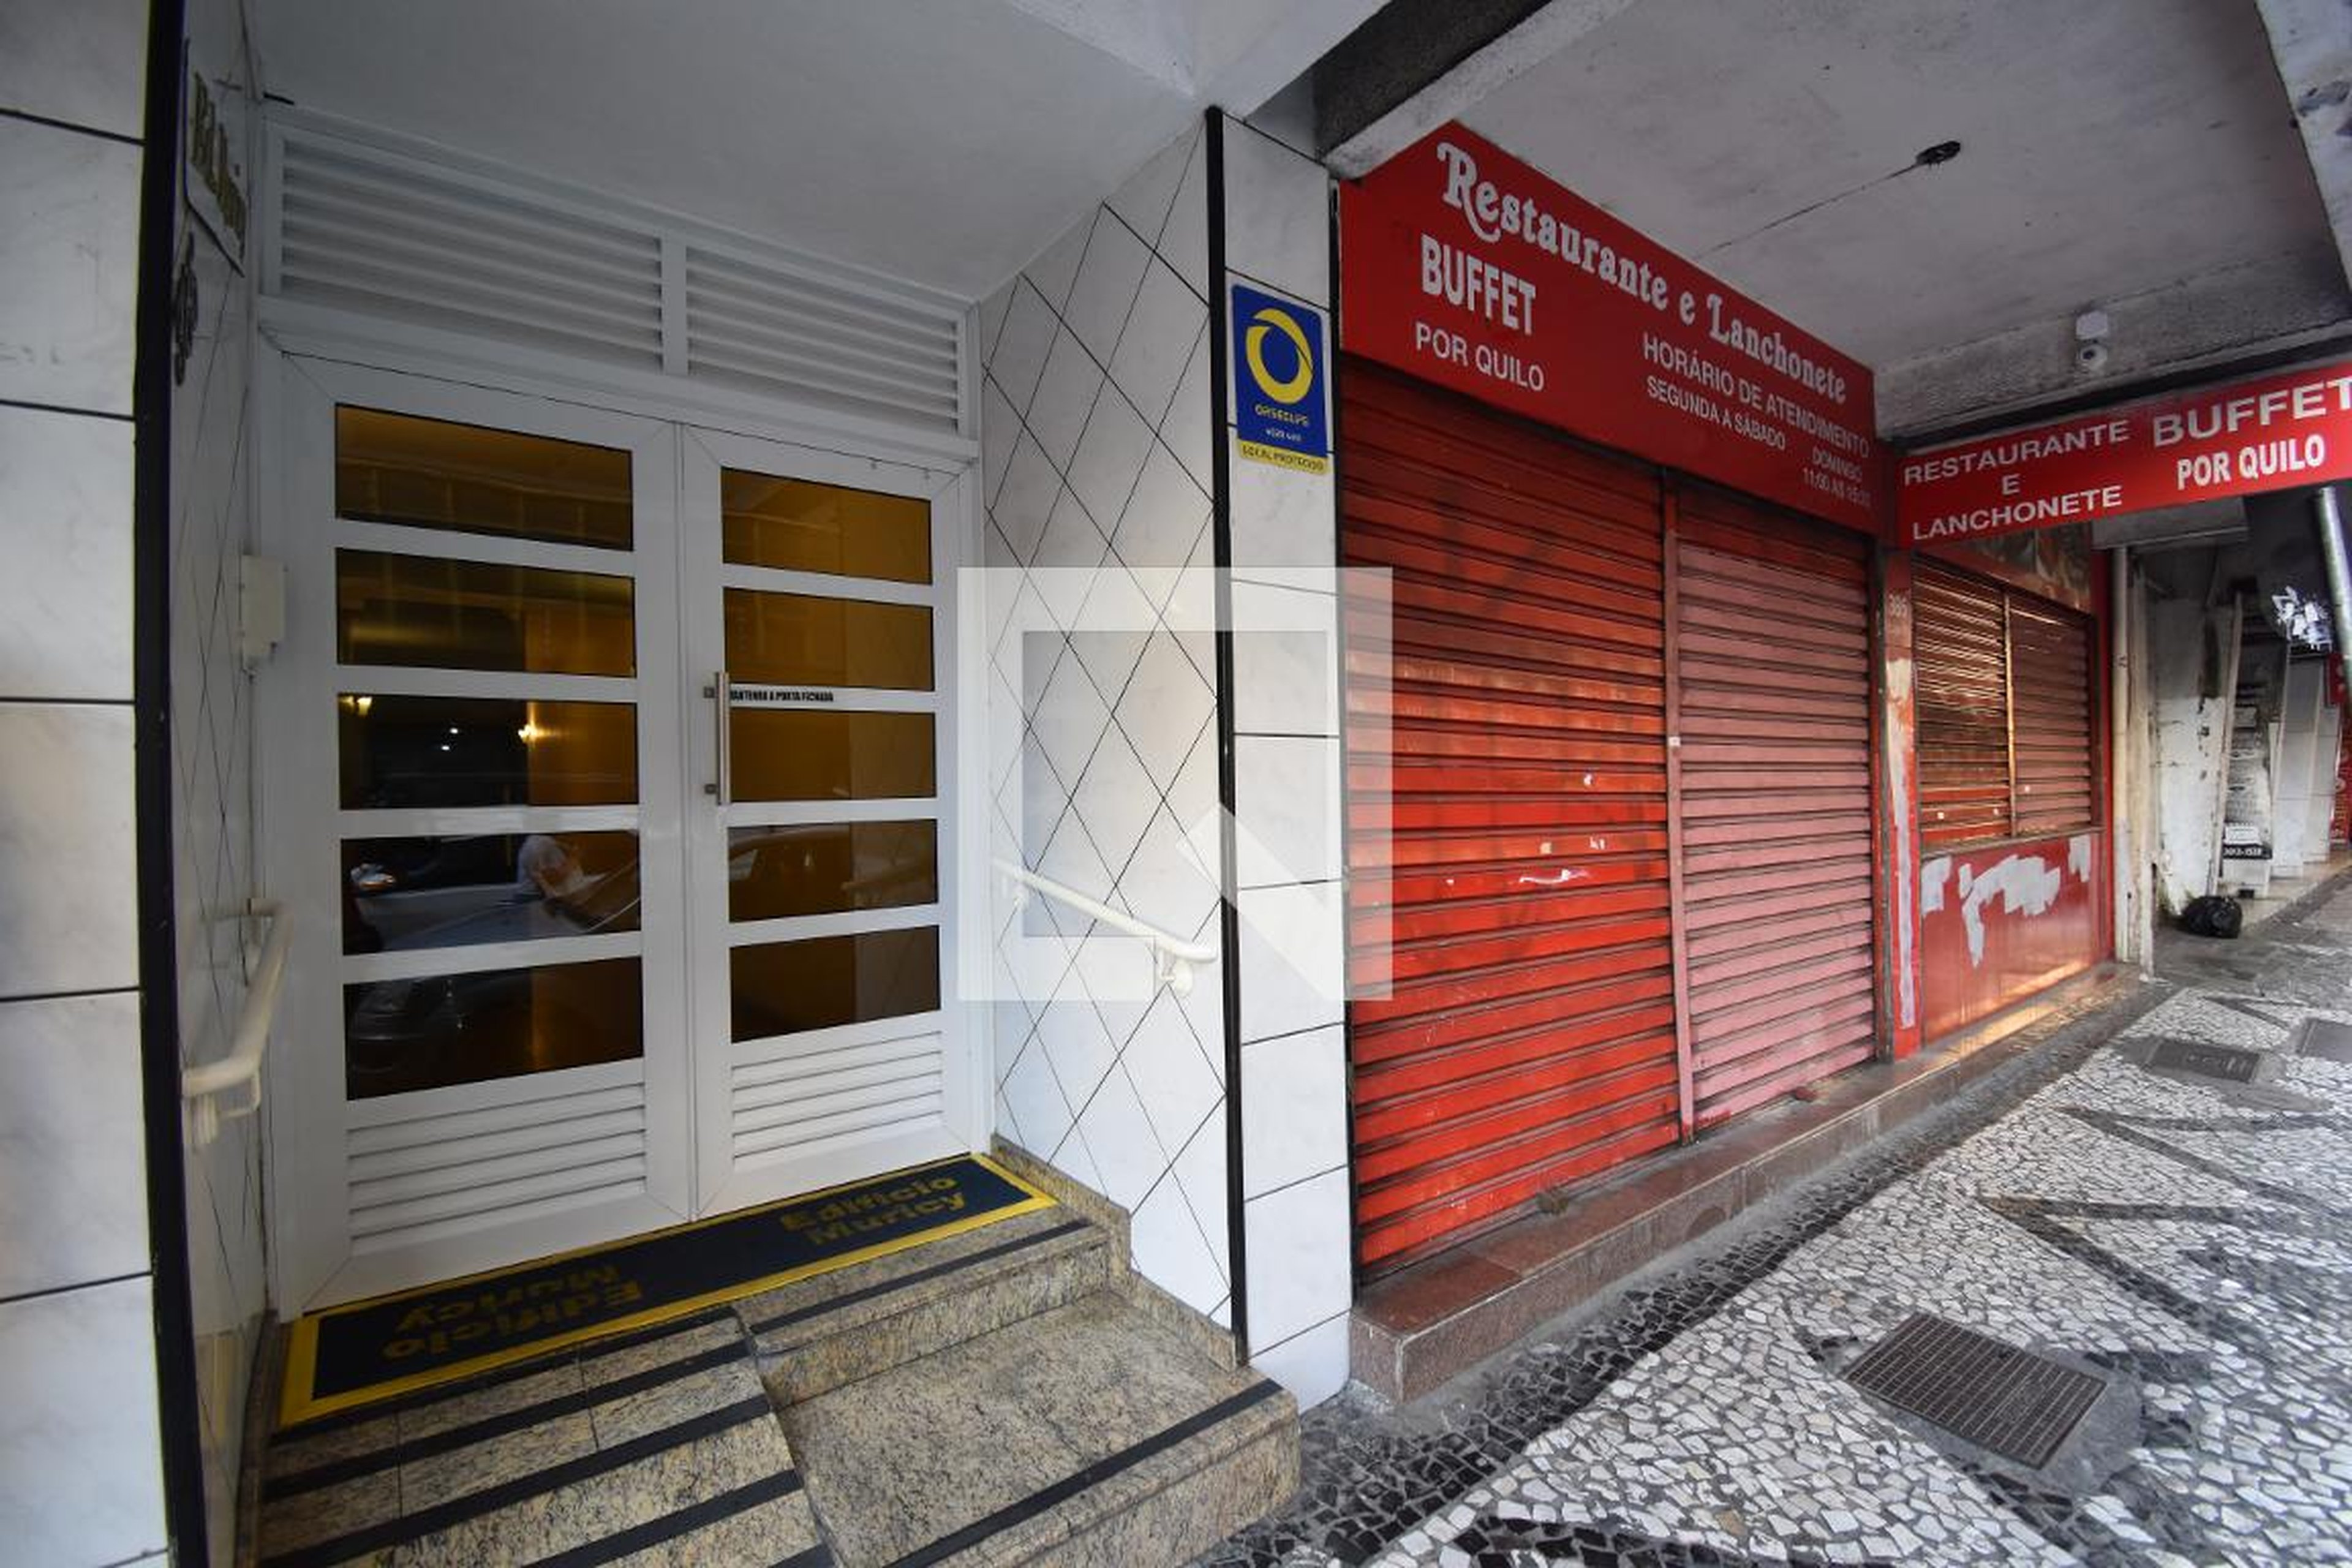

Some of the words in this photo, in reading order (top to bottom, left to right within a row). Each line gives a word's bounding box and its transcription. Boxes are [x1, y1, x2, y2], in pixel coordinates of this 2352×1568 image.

[1420, 233, 1537, 336] BUFFET
[1437, 141, 1669, 311] Restaurante
[1679, 291, 1696, 325] e
[1707, 292, 1847, 404] Lanchonete
[1415, 321, 1469, 367] POR
[1475, 343, 1545, 392] QUILO
[1643, 332, 1735, 397] HORÁRIO
[1738, 377, 1764, 412] DE
[1766, 394, 1870, 459] ATENDIMENTO
[1646, 374, 1721, 425] SEGUNDA
[1721, 408, 1733, 429] A
[2153, 376, 2352, 448] BUFFET
[1811, 446, 1863, 482] DOMINGO
[1904, 419, 2130, 487] RESTAURANTE
[2002, 472, 2021, 496] E
[2177, 451, 2231, 490] POR
[2239, 434, 2326, 480] QUILO
[1912, 484, 2123, 541] LANCHONETE
